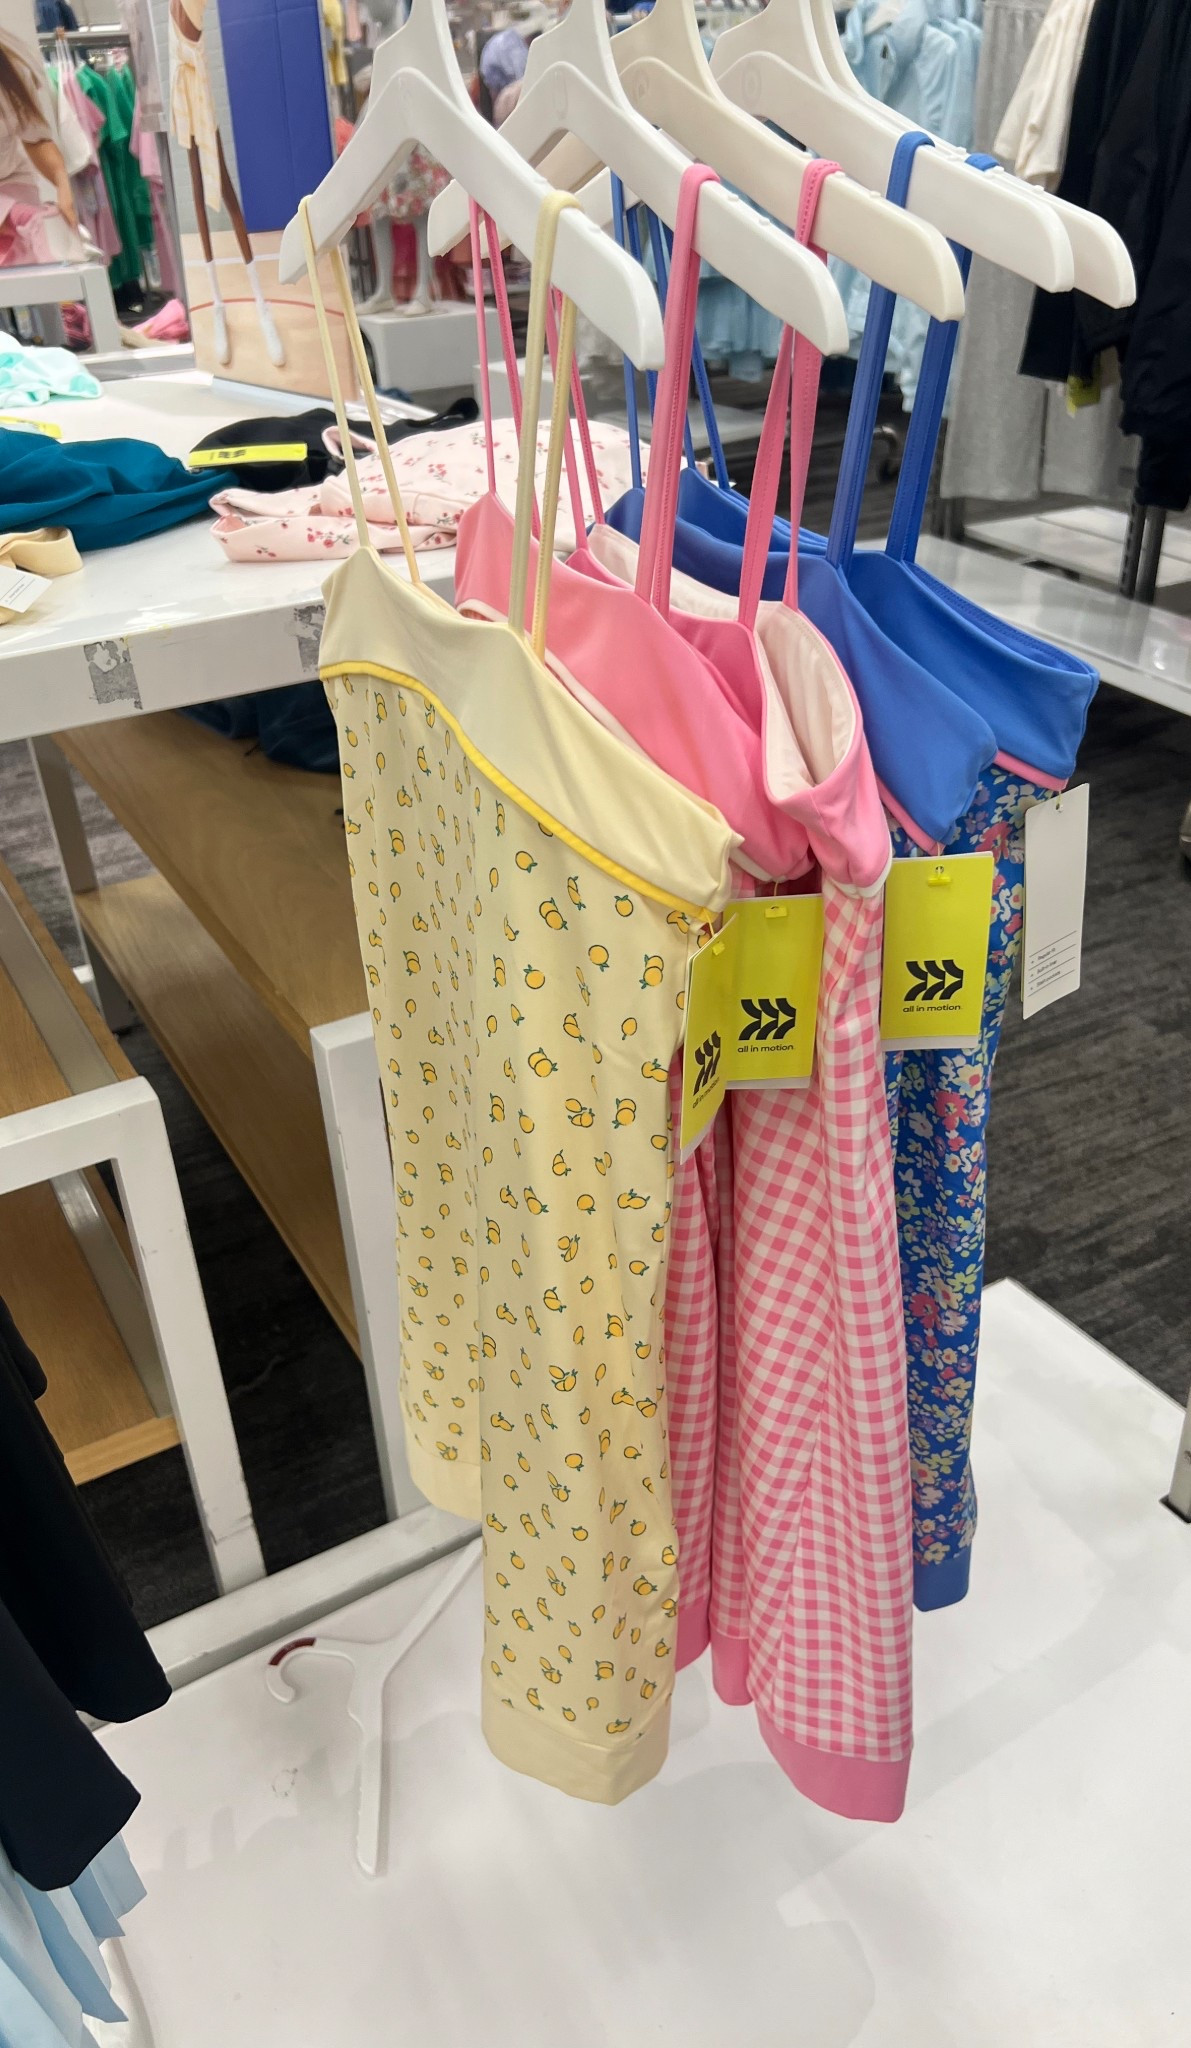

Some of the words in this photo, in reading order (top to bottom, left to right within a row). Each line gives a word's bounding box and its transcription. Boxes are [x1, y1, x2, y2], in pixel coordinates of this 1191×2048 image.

[902, 1005, 914, 1013] all
[926, 1004, 961, 1012] motion
[737, 1045, 749, 1053] all
[760, 1044, 794, 1052] motion
